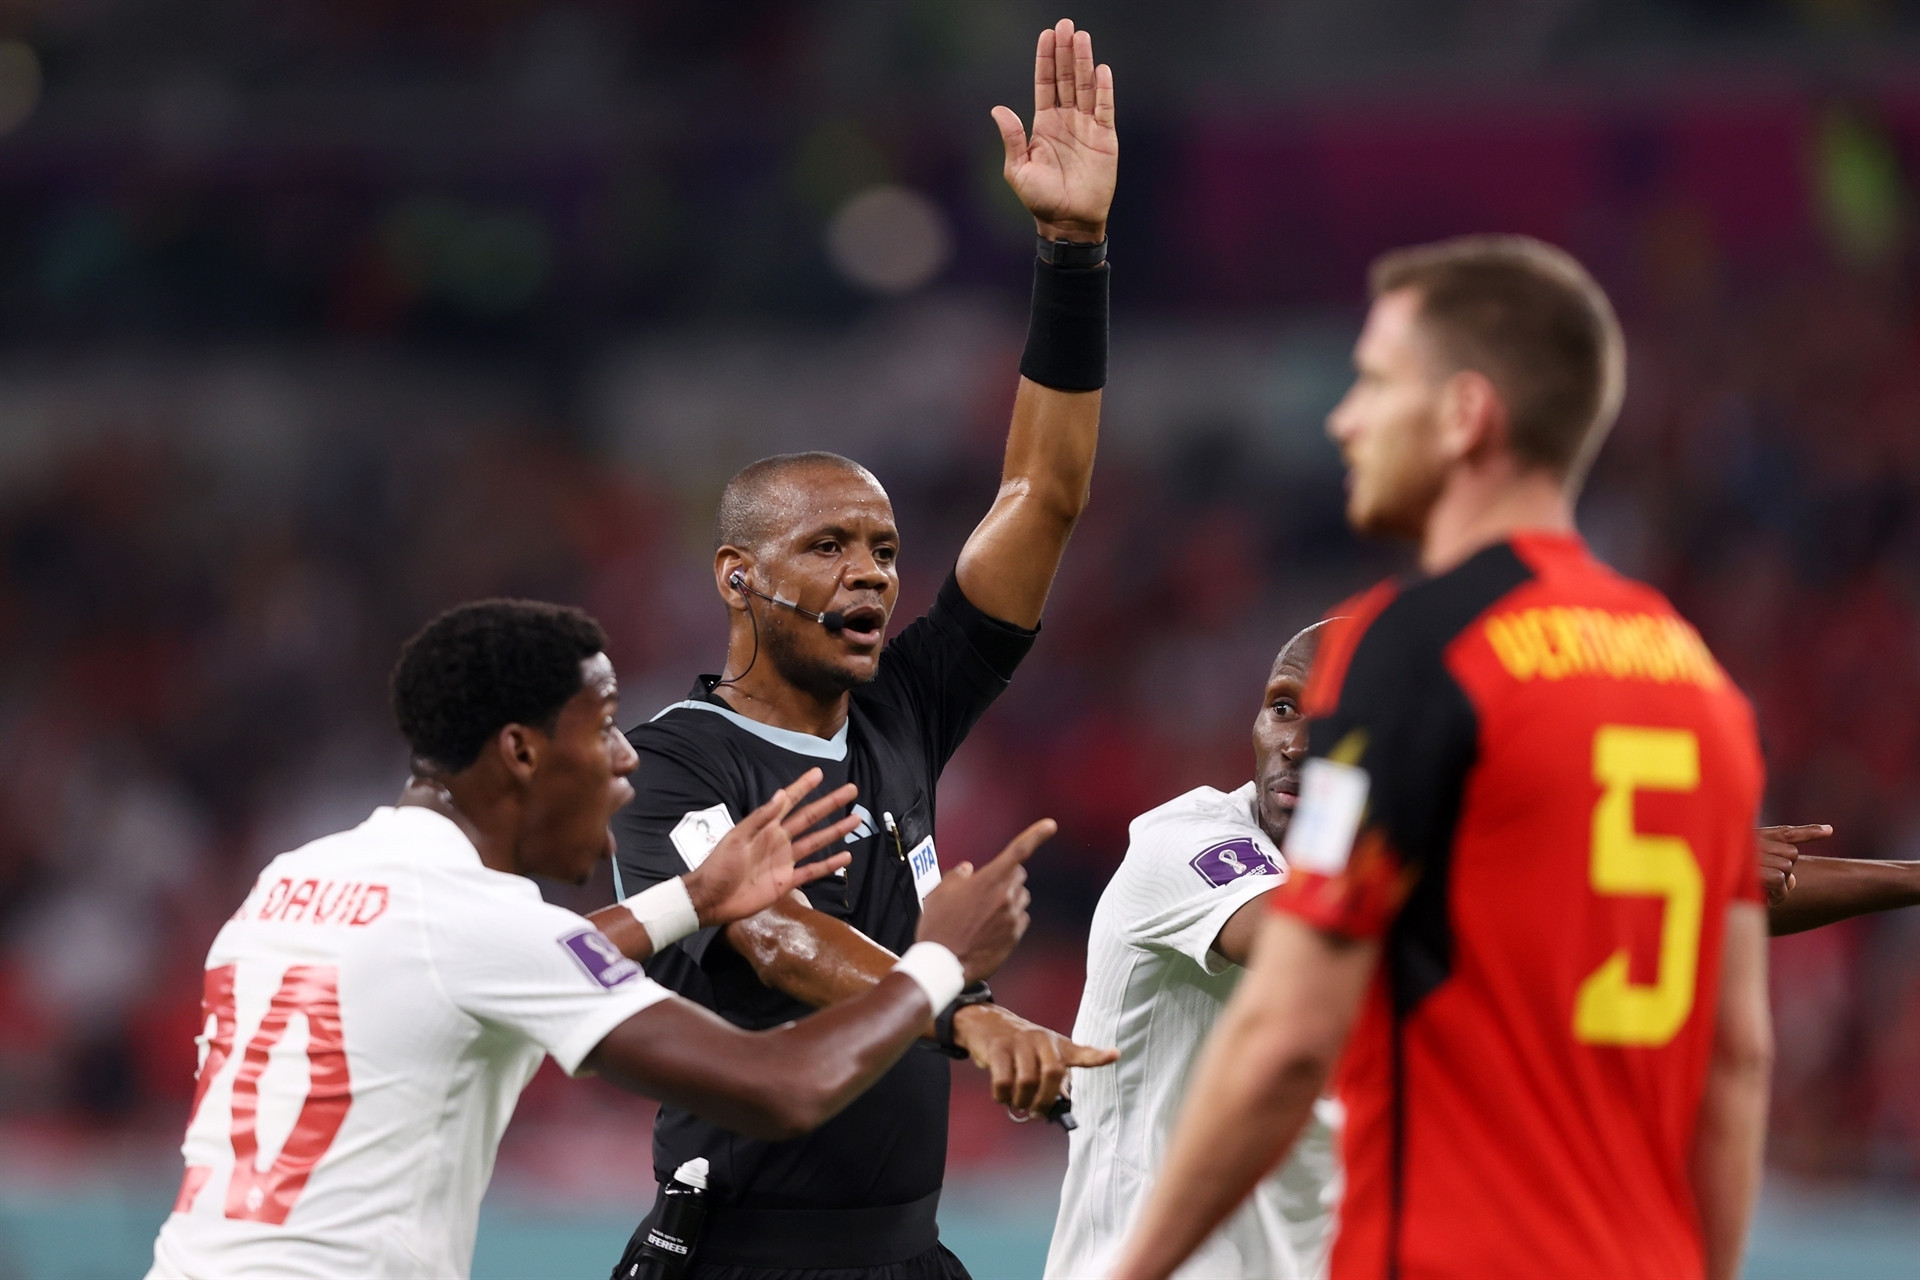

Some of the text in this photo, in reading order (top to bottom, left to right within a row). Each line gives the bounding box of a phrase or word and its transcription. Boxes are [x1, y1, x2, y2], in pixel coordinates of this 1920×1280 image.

[912, 845, 936, 880] FIFA
[259, 878, 389, 925] DAVID
[1572, 725, 1703, 1047] 5
[648, 1233, 688, 1254] EFEREES
